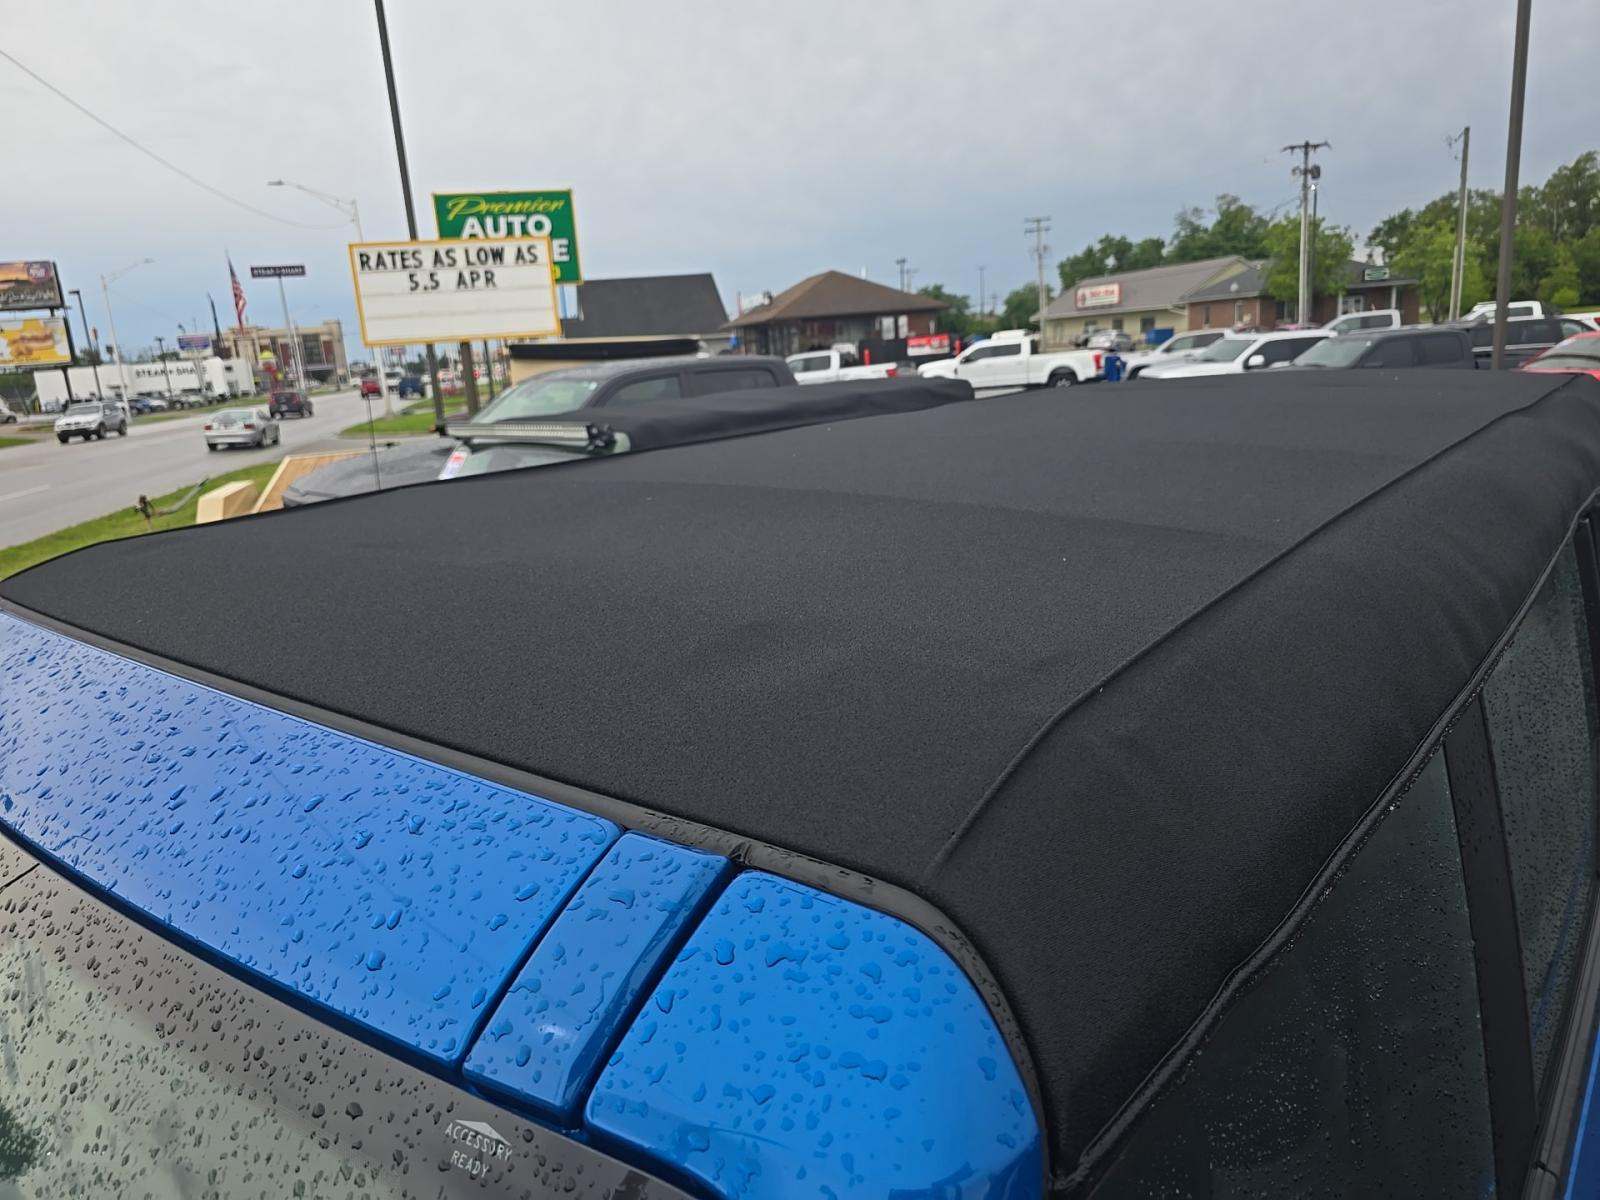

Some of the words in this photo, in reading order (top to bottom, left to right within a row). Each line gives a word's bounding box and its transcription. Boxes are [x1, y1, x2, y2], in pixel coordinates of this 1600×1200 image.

[446, 197, 565, 220] Premier
[459, 214, 552, 239] AUTO
[359, 249, 423, 271] RATES
[433, 247, 457, 269] AS
[465, 246, 505, 267] LOW
[515, 245, 538, 264] AS
[409, 271, 440, 292] 5.5
[457, 270, 497, 291] APR
[451, 1150, 489, 1178] READY
